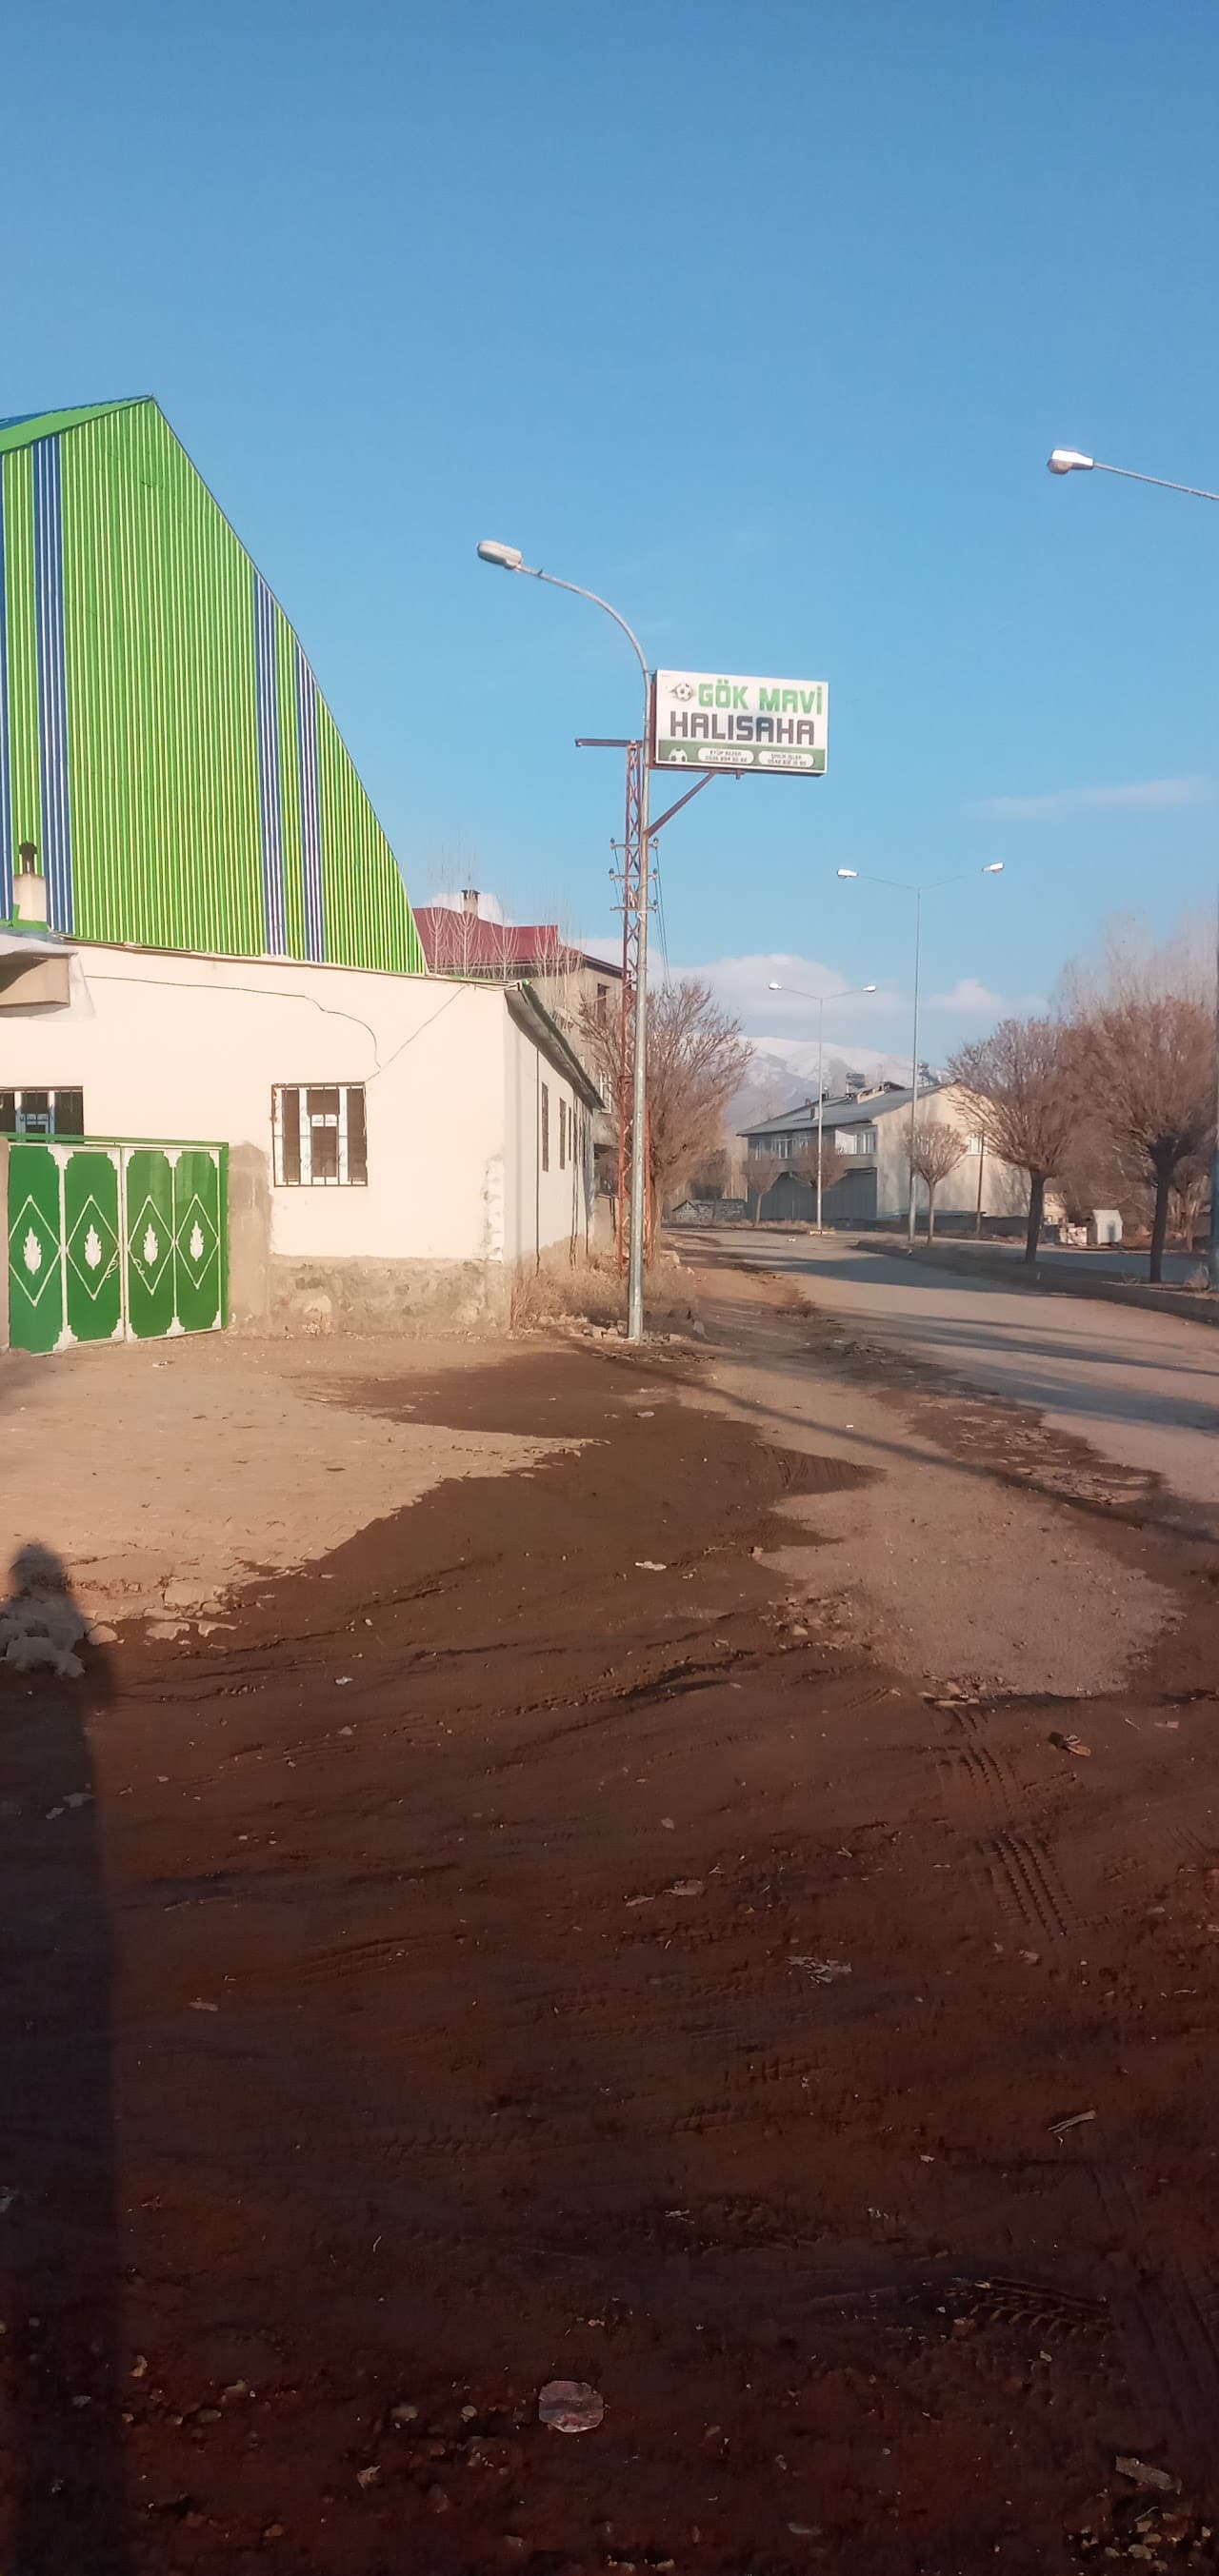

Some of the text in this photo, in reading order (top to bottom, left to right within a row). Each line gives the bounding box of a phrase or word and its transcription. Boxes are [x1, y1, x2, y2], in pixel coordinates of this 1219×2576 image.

[698, 679, 823, 715] GÖK MAVİ
[669, 711, 814, 745] HALISAHA
